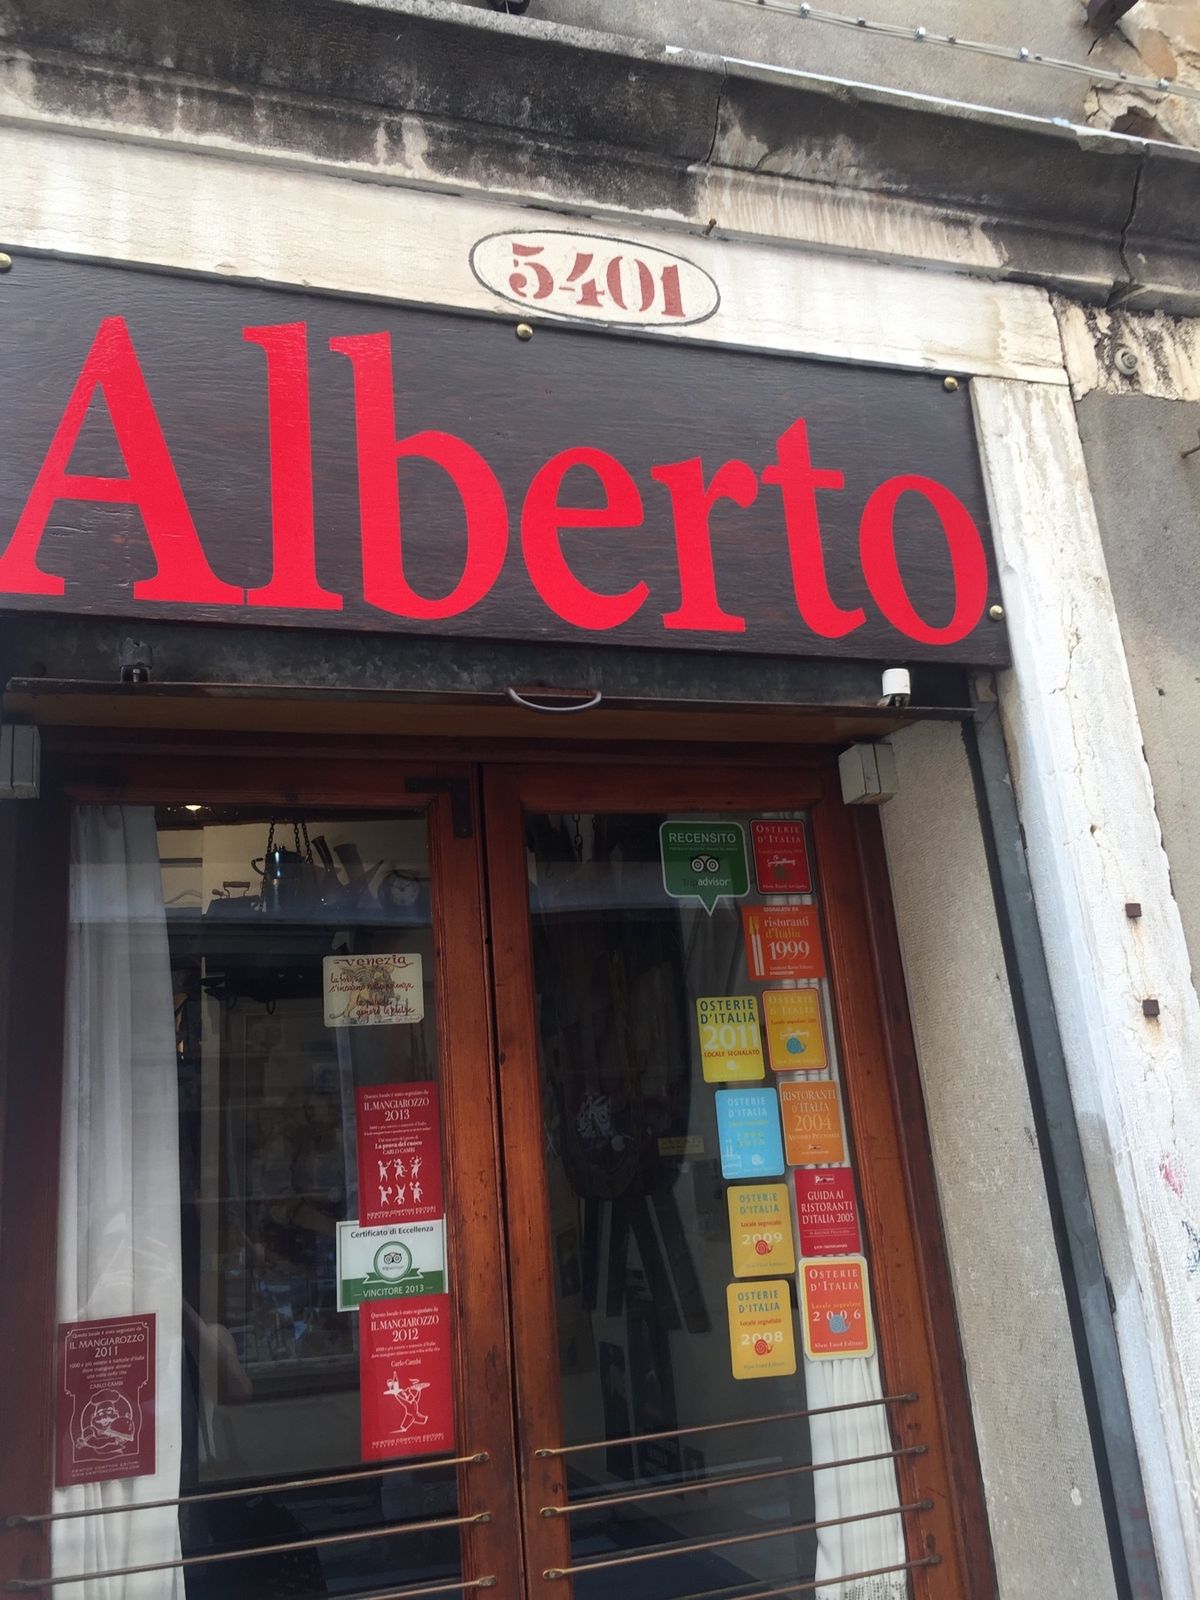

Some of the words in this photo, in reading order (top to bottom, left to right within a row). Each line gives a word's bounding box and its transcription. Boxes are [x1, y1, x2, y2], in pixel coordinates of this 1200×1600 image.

[508, 243, 686, 318] 5401
[0, 317, 988, 645] Alberto
[668, 832, 736, 844] RECENSITO
[764, 915, 810, 927] ristoranti
[767, 940, 810, 961] 1999
[700, 999, 754, 1012] OSTERIE
[701, 1012, 756, 1025] D'ITALIA
[703, 1022, 760, 1051] 2011
[727, 1095, 767, 1107] OSTERIE
[782, 1088, 836, 1102] RISTORANTI
[372, 1097, 430, 1111] MANGIAROZZO
[791, 1101, 830, 1114] D'ITALIA
[384, 1108, 410, 1122] 2013
[728, 1107, 768, 1119] D'ITALIA
[794, 1113, 832, 1132] 2004
[739, 1192, 777, 1203] OSTERIE
[807, 1190, 835, 1201] GUIDA
[740, 1204, 780, 1215] D'ITALIA
[801, 1201, 853, 1213] RISTORANTI
[802, 1214, 835, 1225] D'ITALIA
[836, 1213, 855, 1223] 2005
[350, 1229, 389, 1239] Certificato
[389, 1227, 397, 1236] di
[398, 1225, 435, 1235] Eccellenza
[809, 1268, 858, 1280] OSTERIE
[362, 1285, 404, 1298] VINCITORE
[405, 1284, 425, 1294] 2013
[810, 1280, 860, 1292] D'ITALIA
[737, 1289, 778, 1302] OSTERIE
[738, 1302, 780, 1313] D'ITALIA
[379, 1314, 440, 1330] MANGIAROZZO
[69, 1342, 77, 1350] IL
[78, 1333, 145, 1349] MANGIAROZZO
[392, 1328, 419, 1343] 2012
[95, 1345, 118, 1358] 2011
